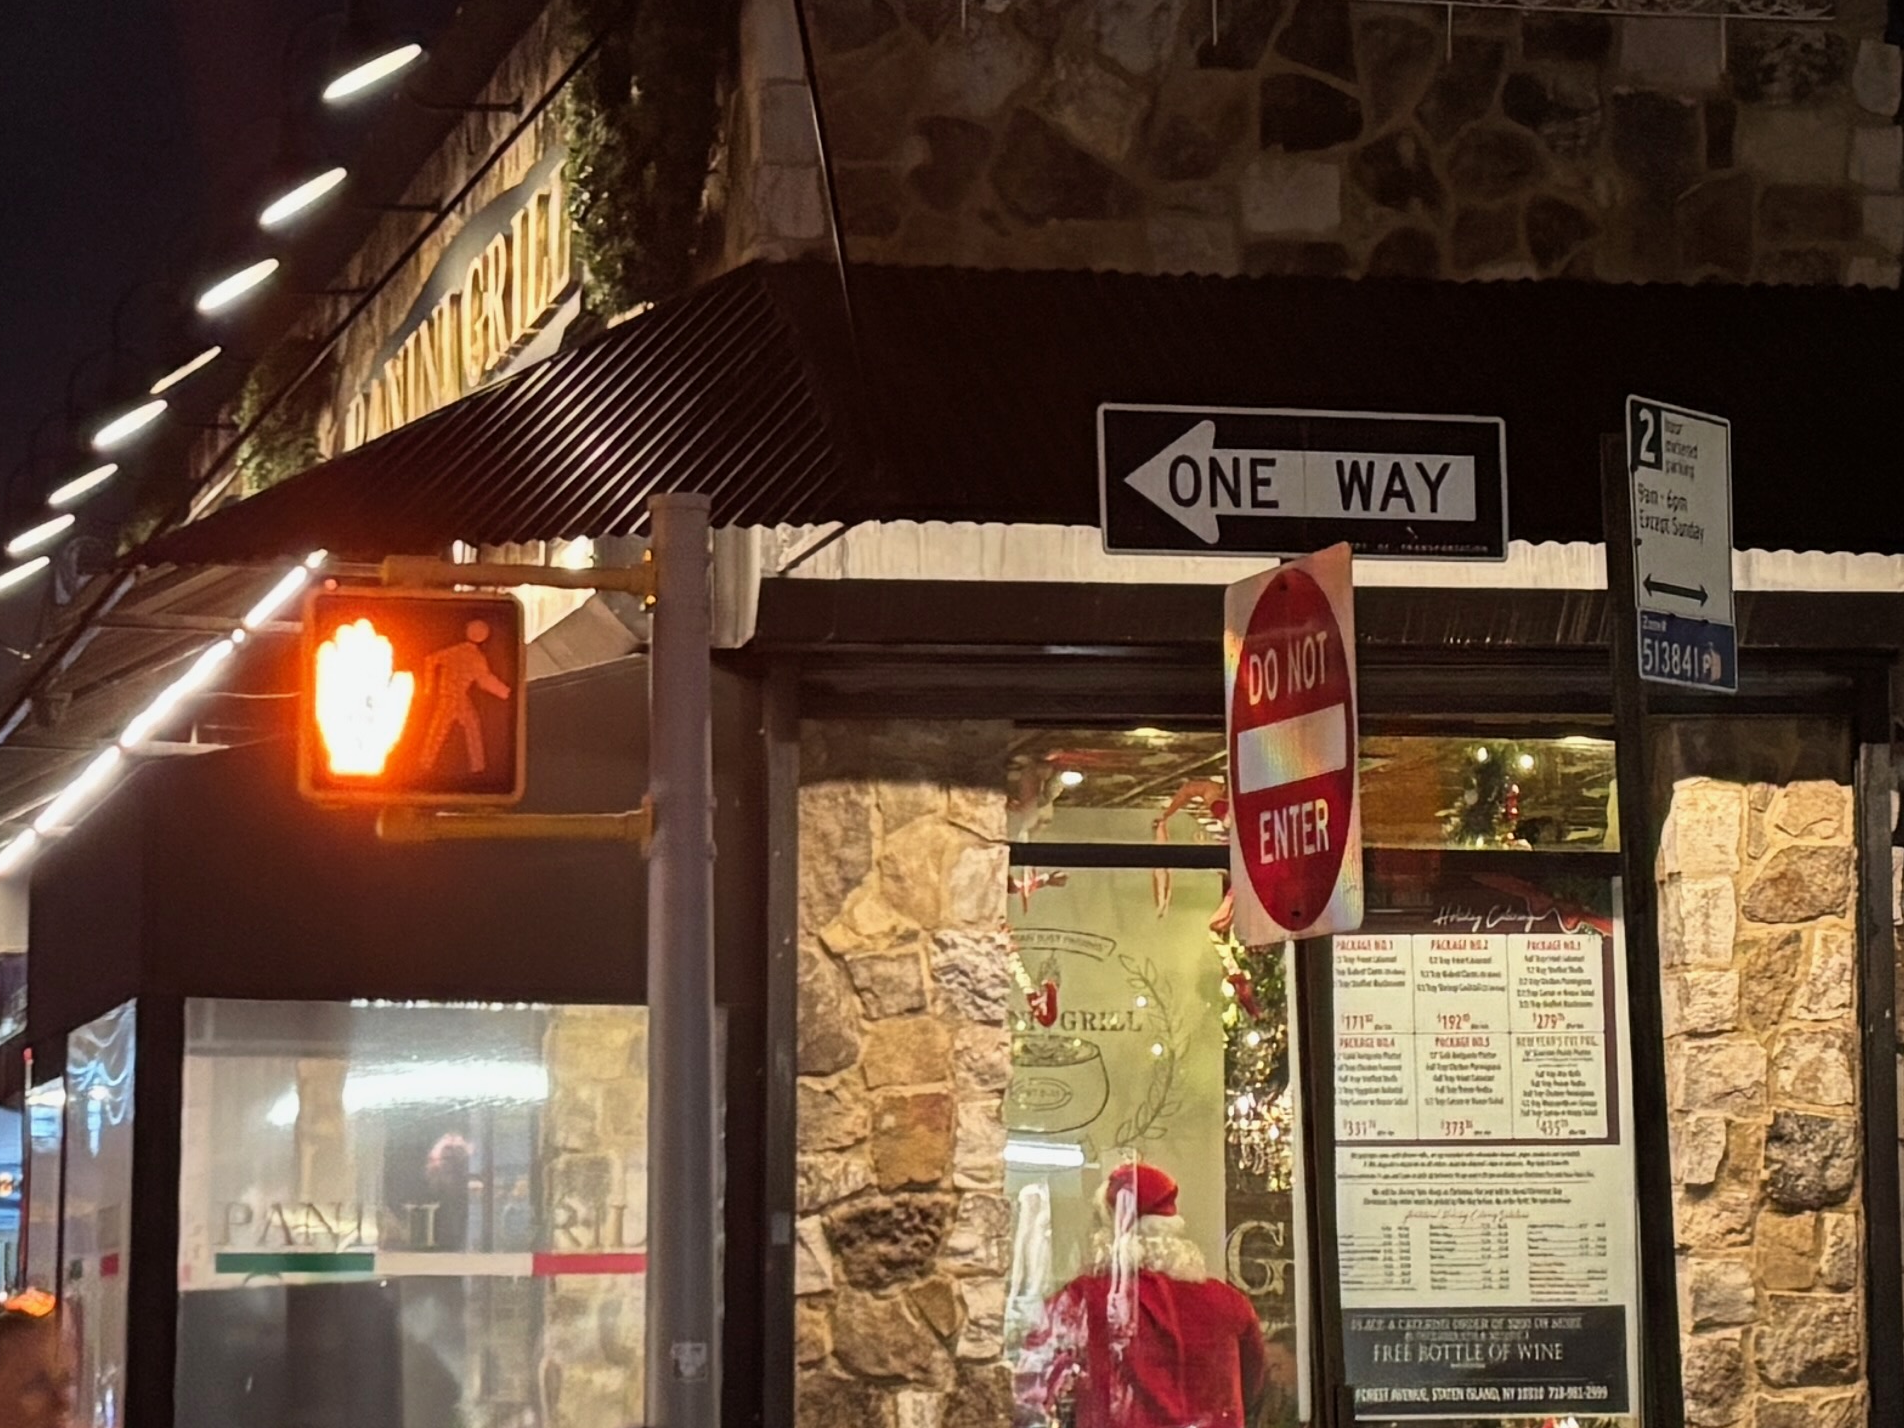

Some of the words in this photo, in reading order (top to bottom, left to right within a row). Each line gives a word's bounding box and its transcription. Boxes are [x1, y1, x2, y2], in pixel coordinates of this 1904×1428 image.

[462, 159, 571, 385] GRILL
[1639, 408, 1656, 463] 2
[1168, 455, 1279, 510] ONE
[1336, 459, 1452, 514] WAY
[1672, 516, 1704, 546] Sunday
[1248, 647, 1280, 706] DO
[1286, 631, 1327, 694] NOT
[1643, 638, 1699, 679] 513841
[1258, 798, 1329, 865] ENTER
[1060, 1010, 1142, 1032] GRILL
[214, 1201, 441, 1248] PANINI
[502, 1203, 648, 1248] GRIL
[1374, 1344, 1412, 1362] FREE
[1418, 1344, 1484, 1362] BOTTLE
[1488, 1343, 1511, 1362] OF
[1518, 1343, 1563, 1362] WINE
[1432, 1387, 1464, 1401] STATEN
[1502, 1386, 1515, 1400] NY
